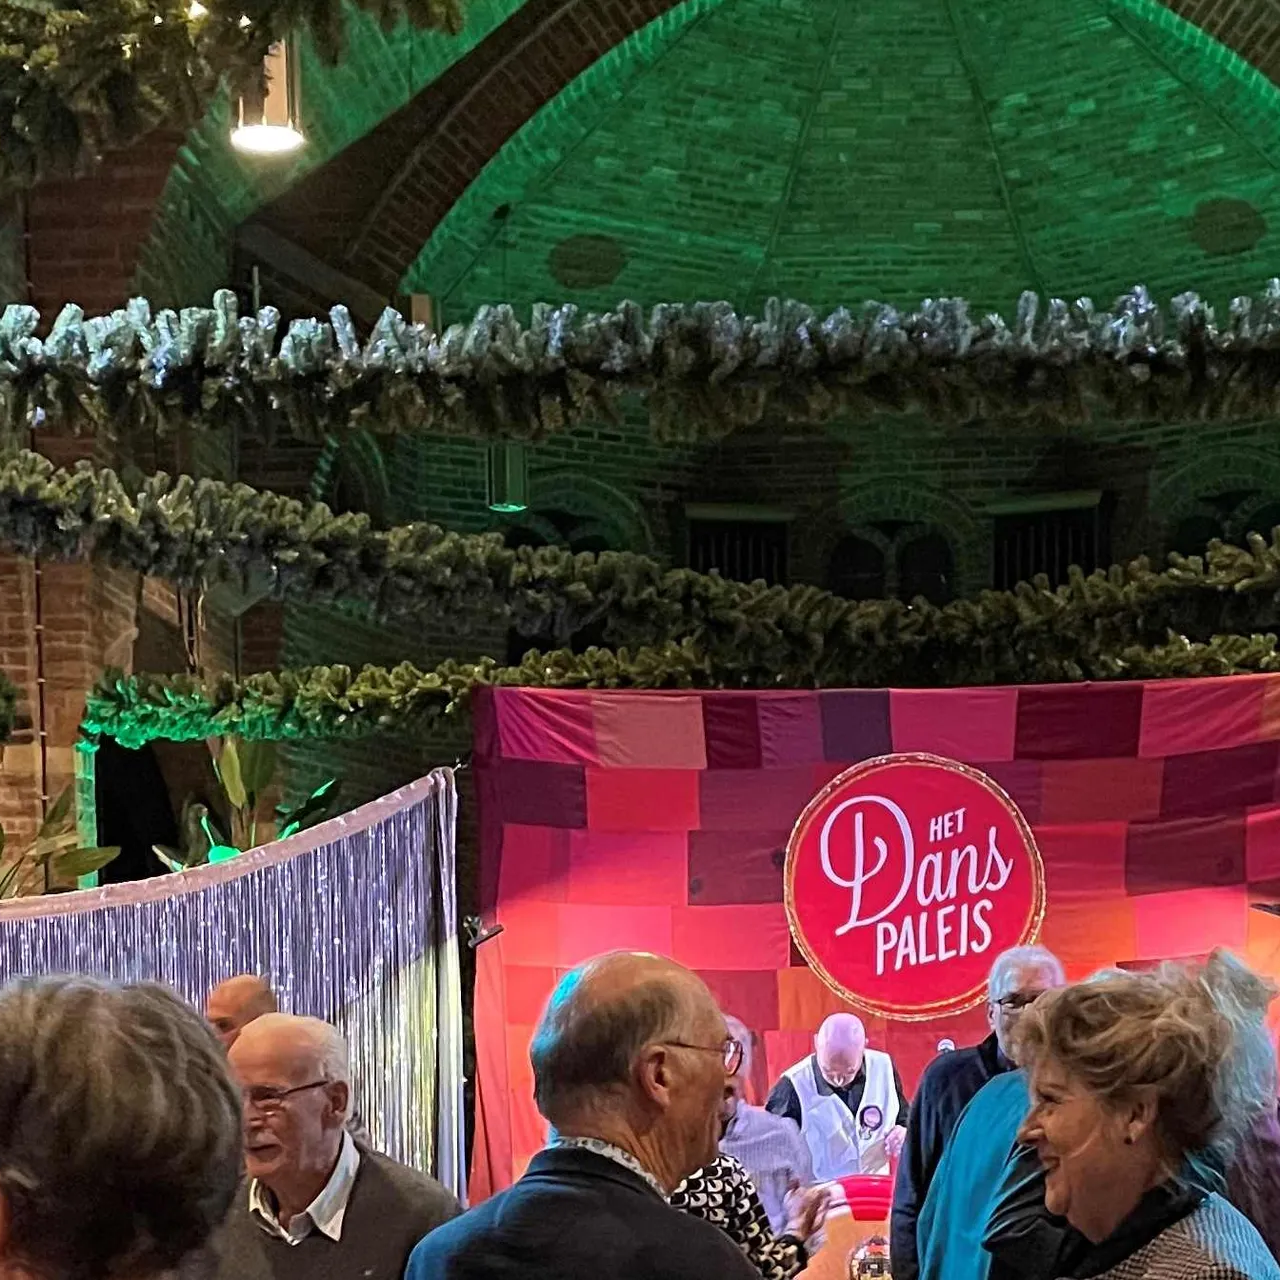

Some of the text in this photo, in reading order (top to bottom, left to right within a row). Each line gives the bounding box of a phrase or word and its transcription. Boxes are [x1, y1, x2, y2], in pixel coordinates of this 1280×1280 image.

[929, 807, 966, 842] HET
[820, 795, 1014, 937] Dans
[876, 899, 993, 976] PALEIS
